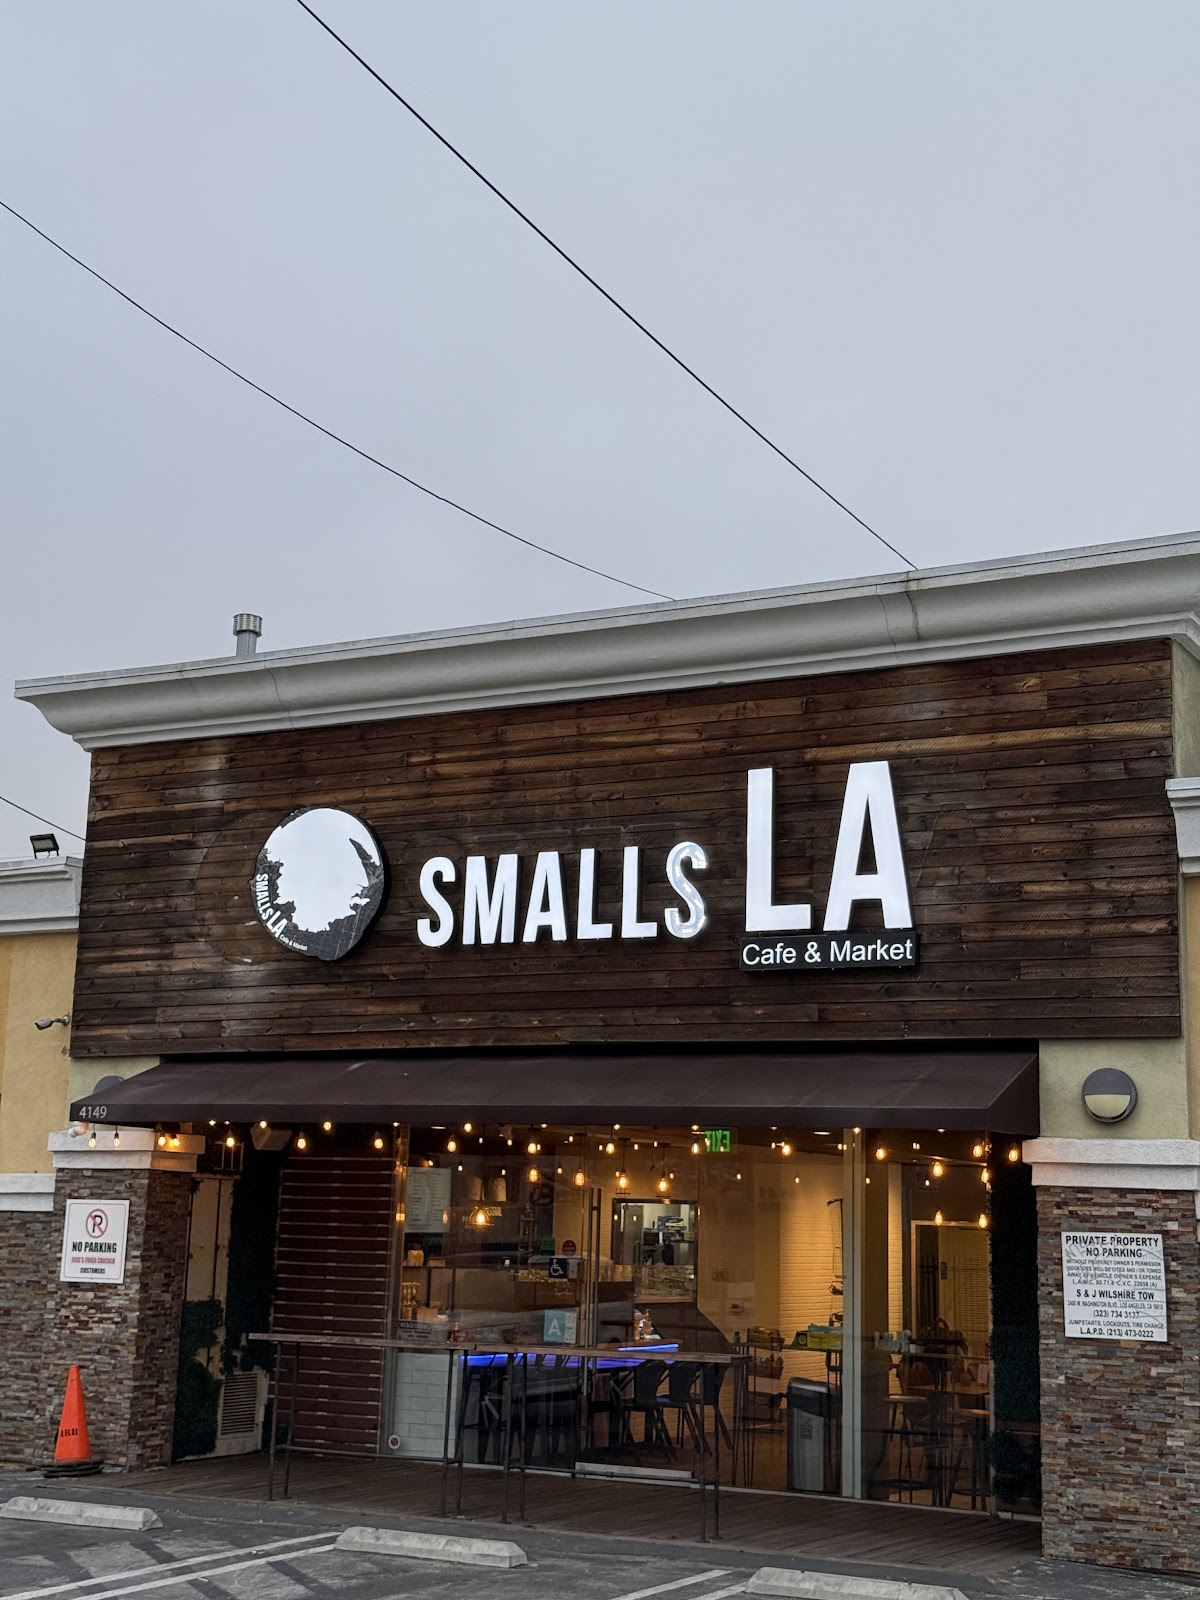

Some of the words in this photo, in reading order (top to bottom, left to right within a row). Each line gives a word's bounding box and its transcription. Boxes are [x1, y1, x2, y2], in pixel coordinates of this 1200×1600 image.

[417, 841, 707, 948] SMALLS
[746, 761, 913, 931] LA
[255, 873, 273, 921] SMALLS
[266, 910, 288, 938] LA
[743, 943, 796, 965] Cafe
[804, 942, 821, 962] &
[830, 939, 913, 962] Market
[79, 1106, 107, 1118] 4149
[72, 1241, 83, 1252] NO
[84, 1242, 117, 1253] PARKING
[1065, 1235, 1107, 1245] PRIVATE
[1110, 1236, 1159, 1247] PROPERTY
[1086, 1247, 1099, 1256] NO
[1102, 1248, 1143, 1257] PARKING
[1076, 1289, 1081, 1297] S
[1084, 1289, 1089, 1297] &
[1092, 1290, 1096, 1298] J
[1099, 1290, 1135, 1299] WILSHIRE
[1138, 1291, 1154, 1300] TOW
[1093, 1310, 1109, 1318] (323)
[1111, 1310, 1123, 1318] 734
[1124, 1311, 1139, 1319] 3137
[548, 1318, 561, 1336] A
[1080, 1327, 1105, 1336] L.A.P.D.
[1107, 1328, 1123, 1337] (213)
[1125, 1329, 1154, 1338] 473-0222
